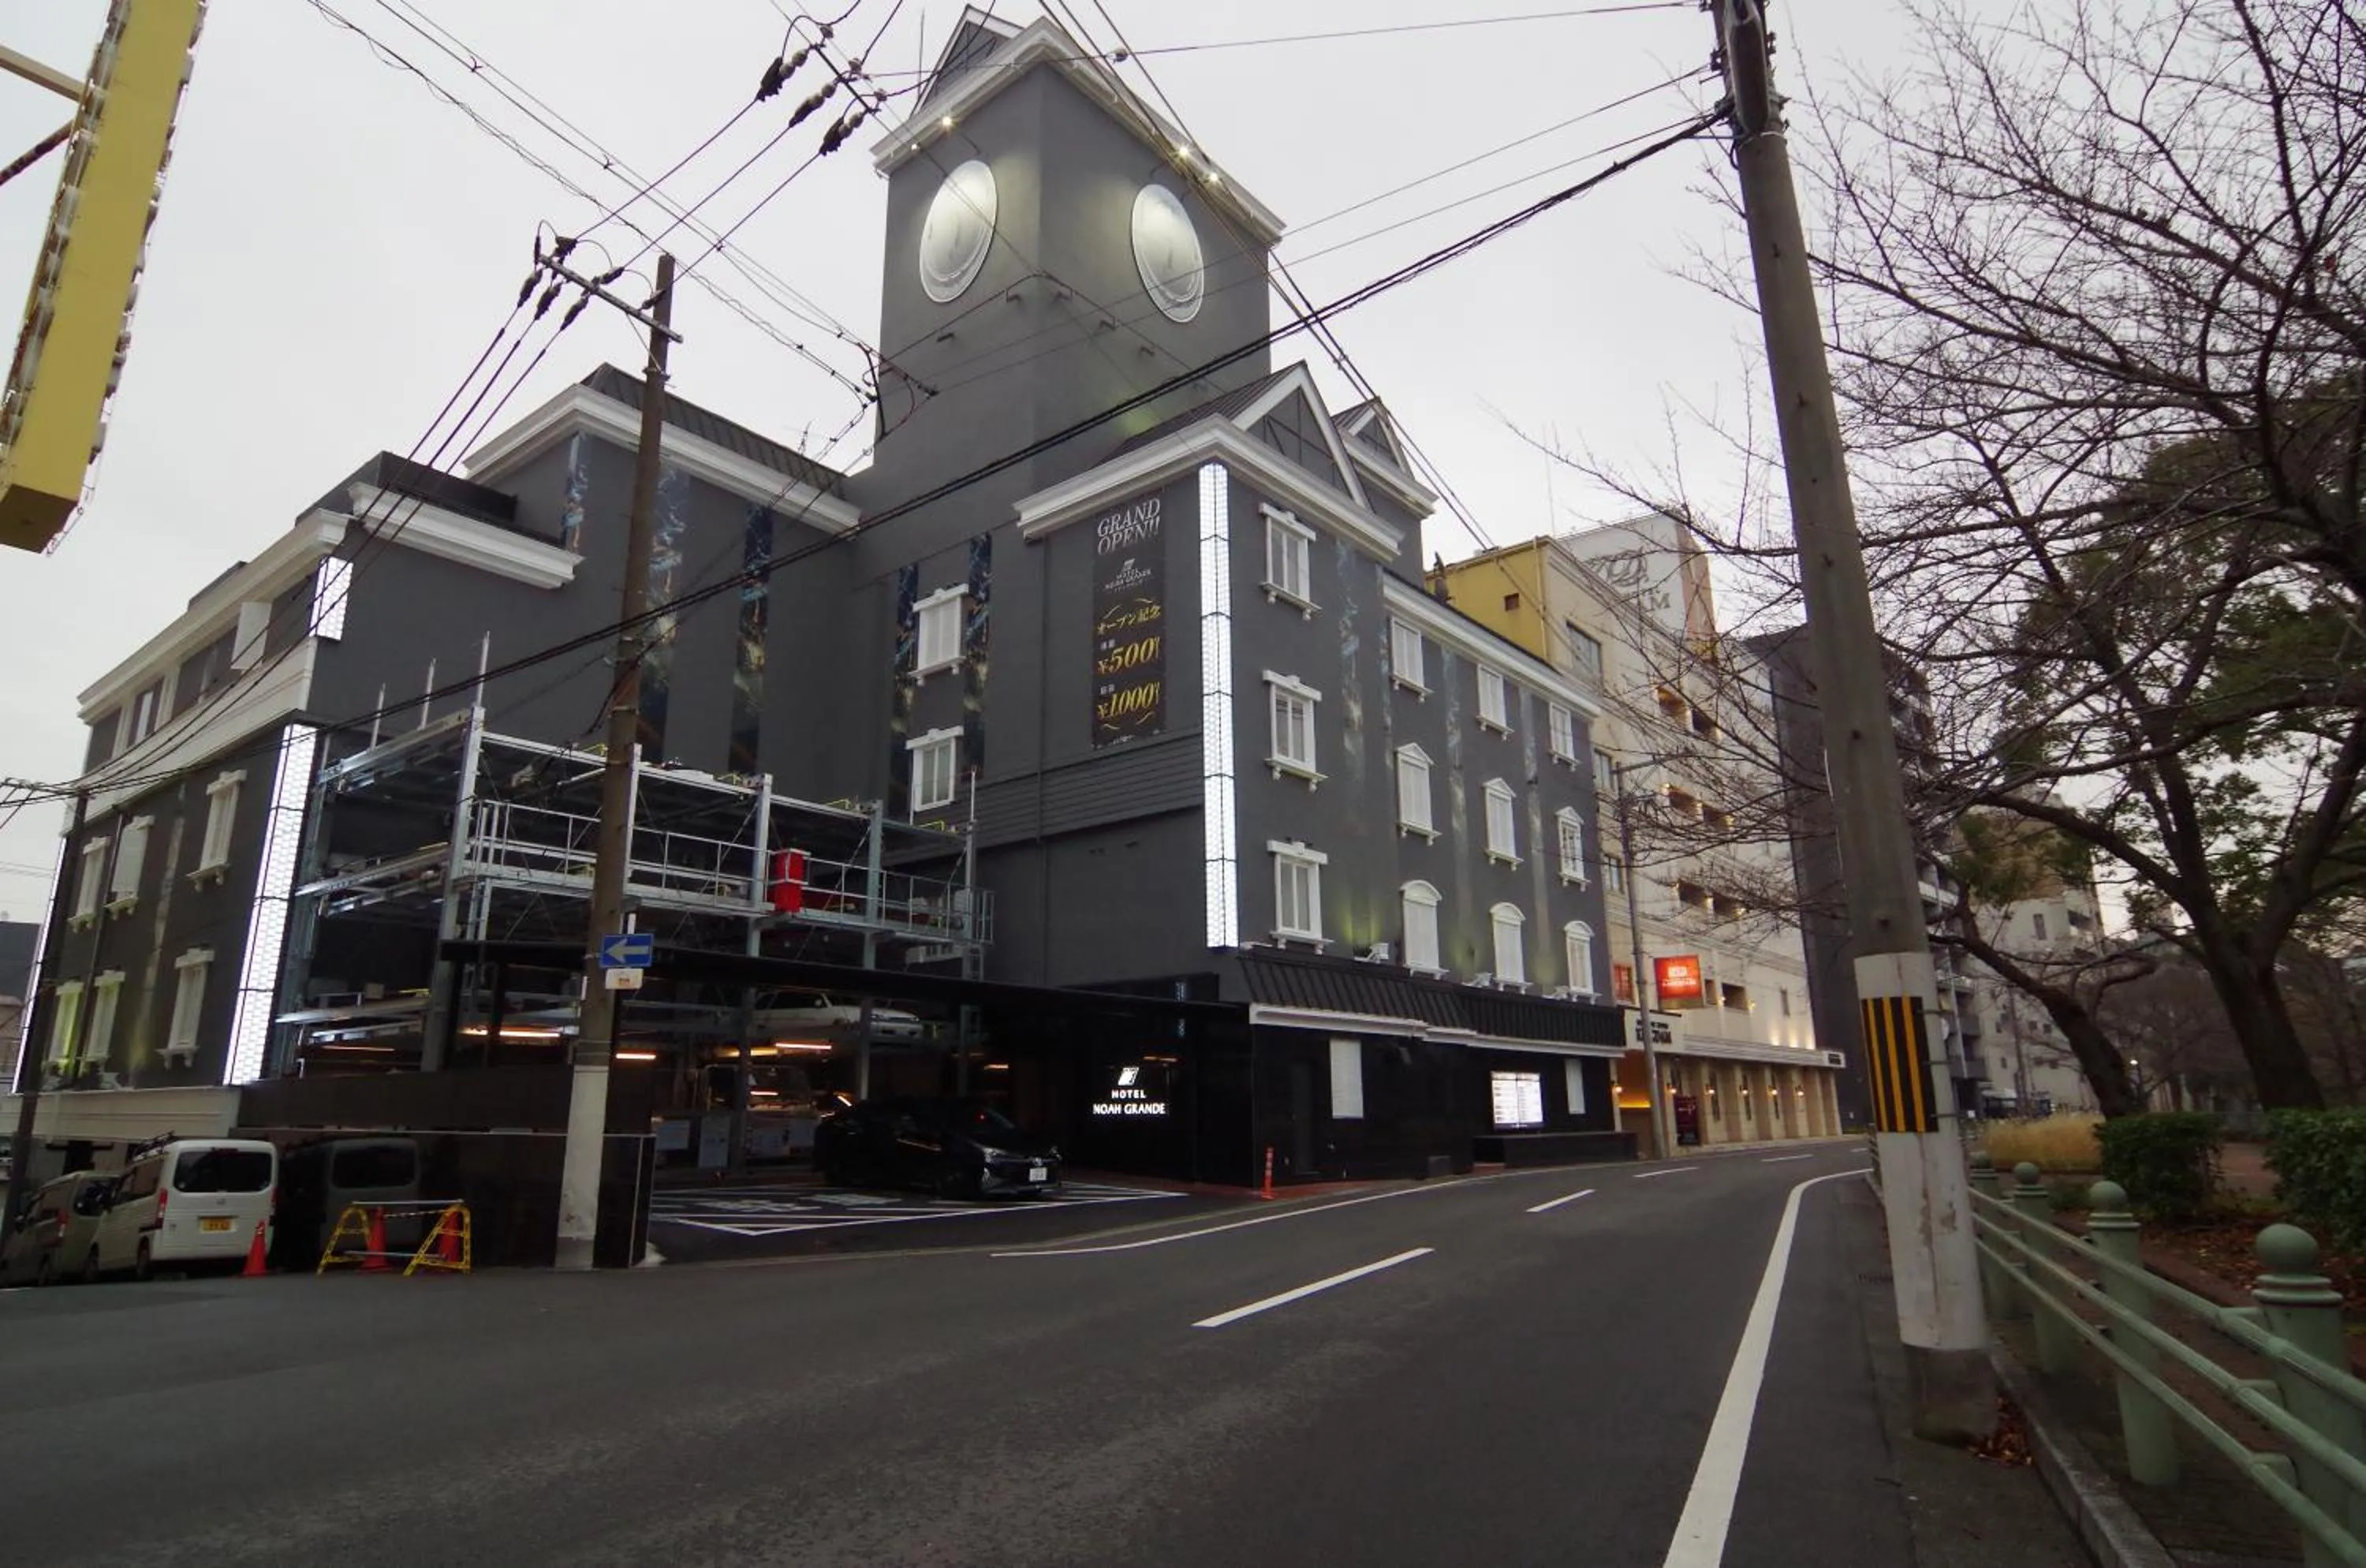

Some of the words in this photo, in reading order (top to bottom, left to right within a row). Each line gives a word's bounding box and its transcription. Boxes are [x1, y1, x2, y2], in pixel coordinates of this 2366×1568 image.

[1097, 498, 1160, 537] GRAND
[1111, 1089, 1147, 1099] HOTEL
[1093, 1103, 1121, 1114] NOAH
[1124, 1103, 1166, 1114] GRANDE
